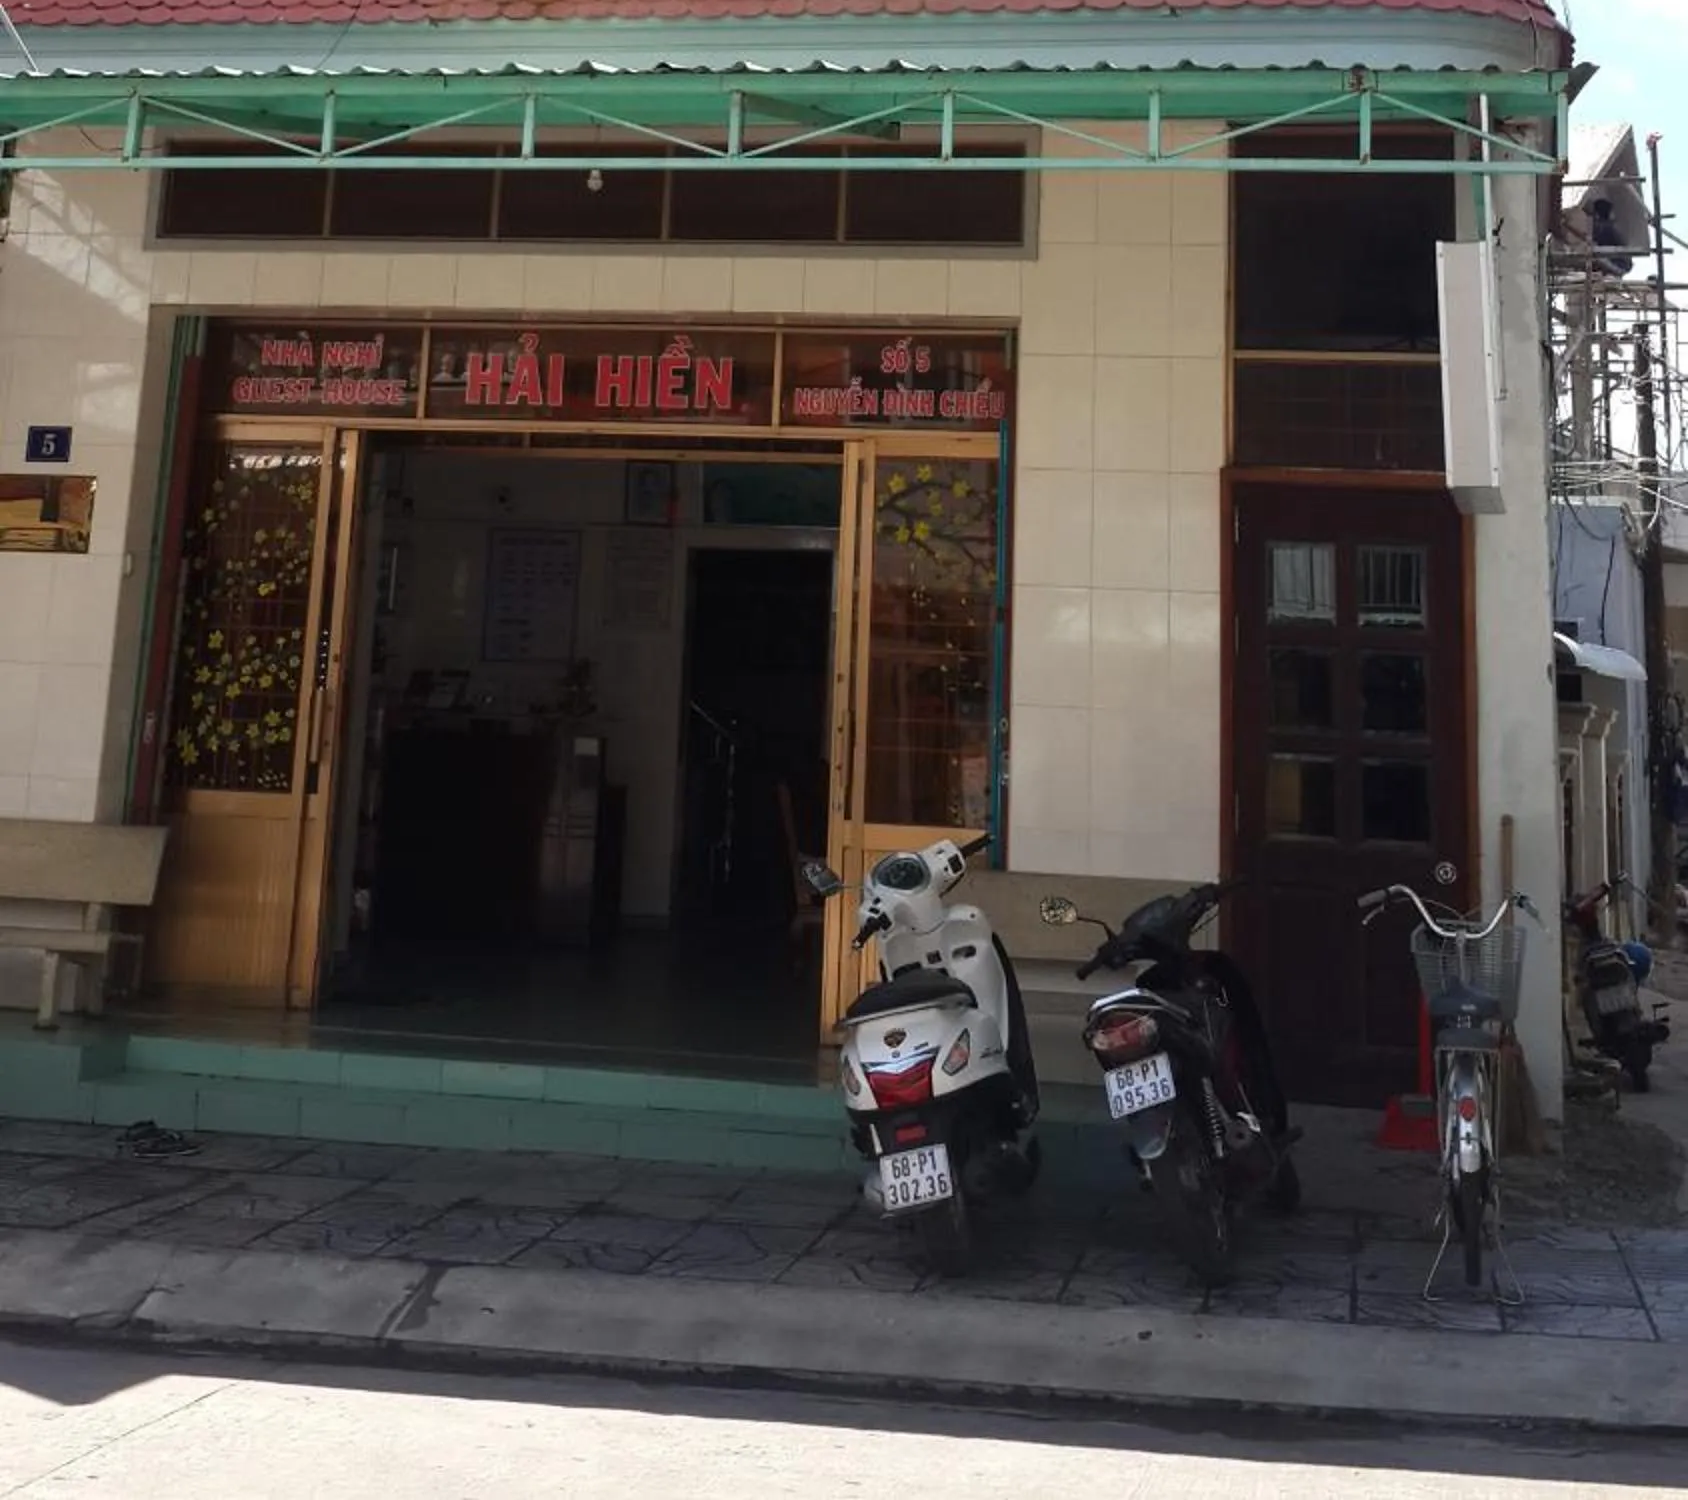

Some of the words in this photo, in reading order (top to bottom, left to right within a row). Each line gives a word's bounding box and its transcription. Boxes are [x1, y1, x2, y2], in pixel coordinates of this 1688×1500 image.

[260, 330, 315, 367] NHÀ
[880, 337, 912, 373] SỐ
[915, 346, 931, 373] 5
[465, 333, 566, 407] HẢI
[596, 334, 734, 410] HIỀN
[232, 376, 316, 403] GUEST
[320, 378, 407, 406] HOUSE
[41, 433, 58, 455] 5
